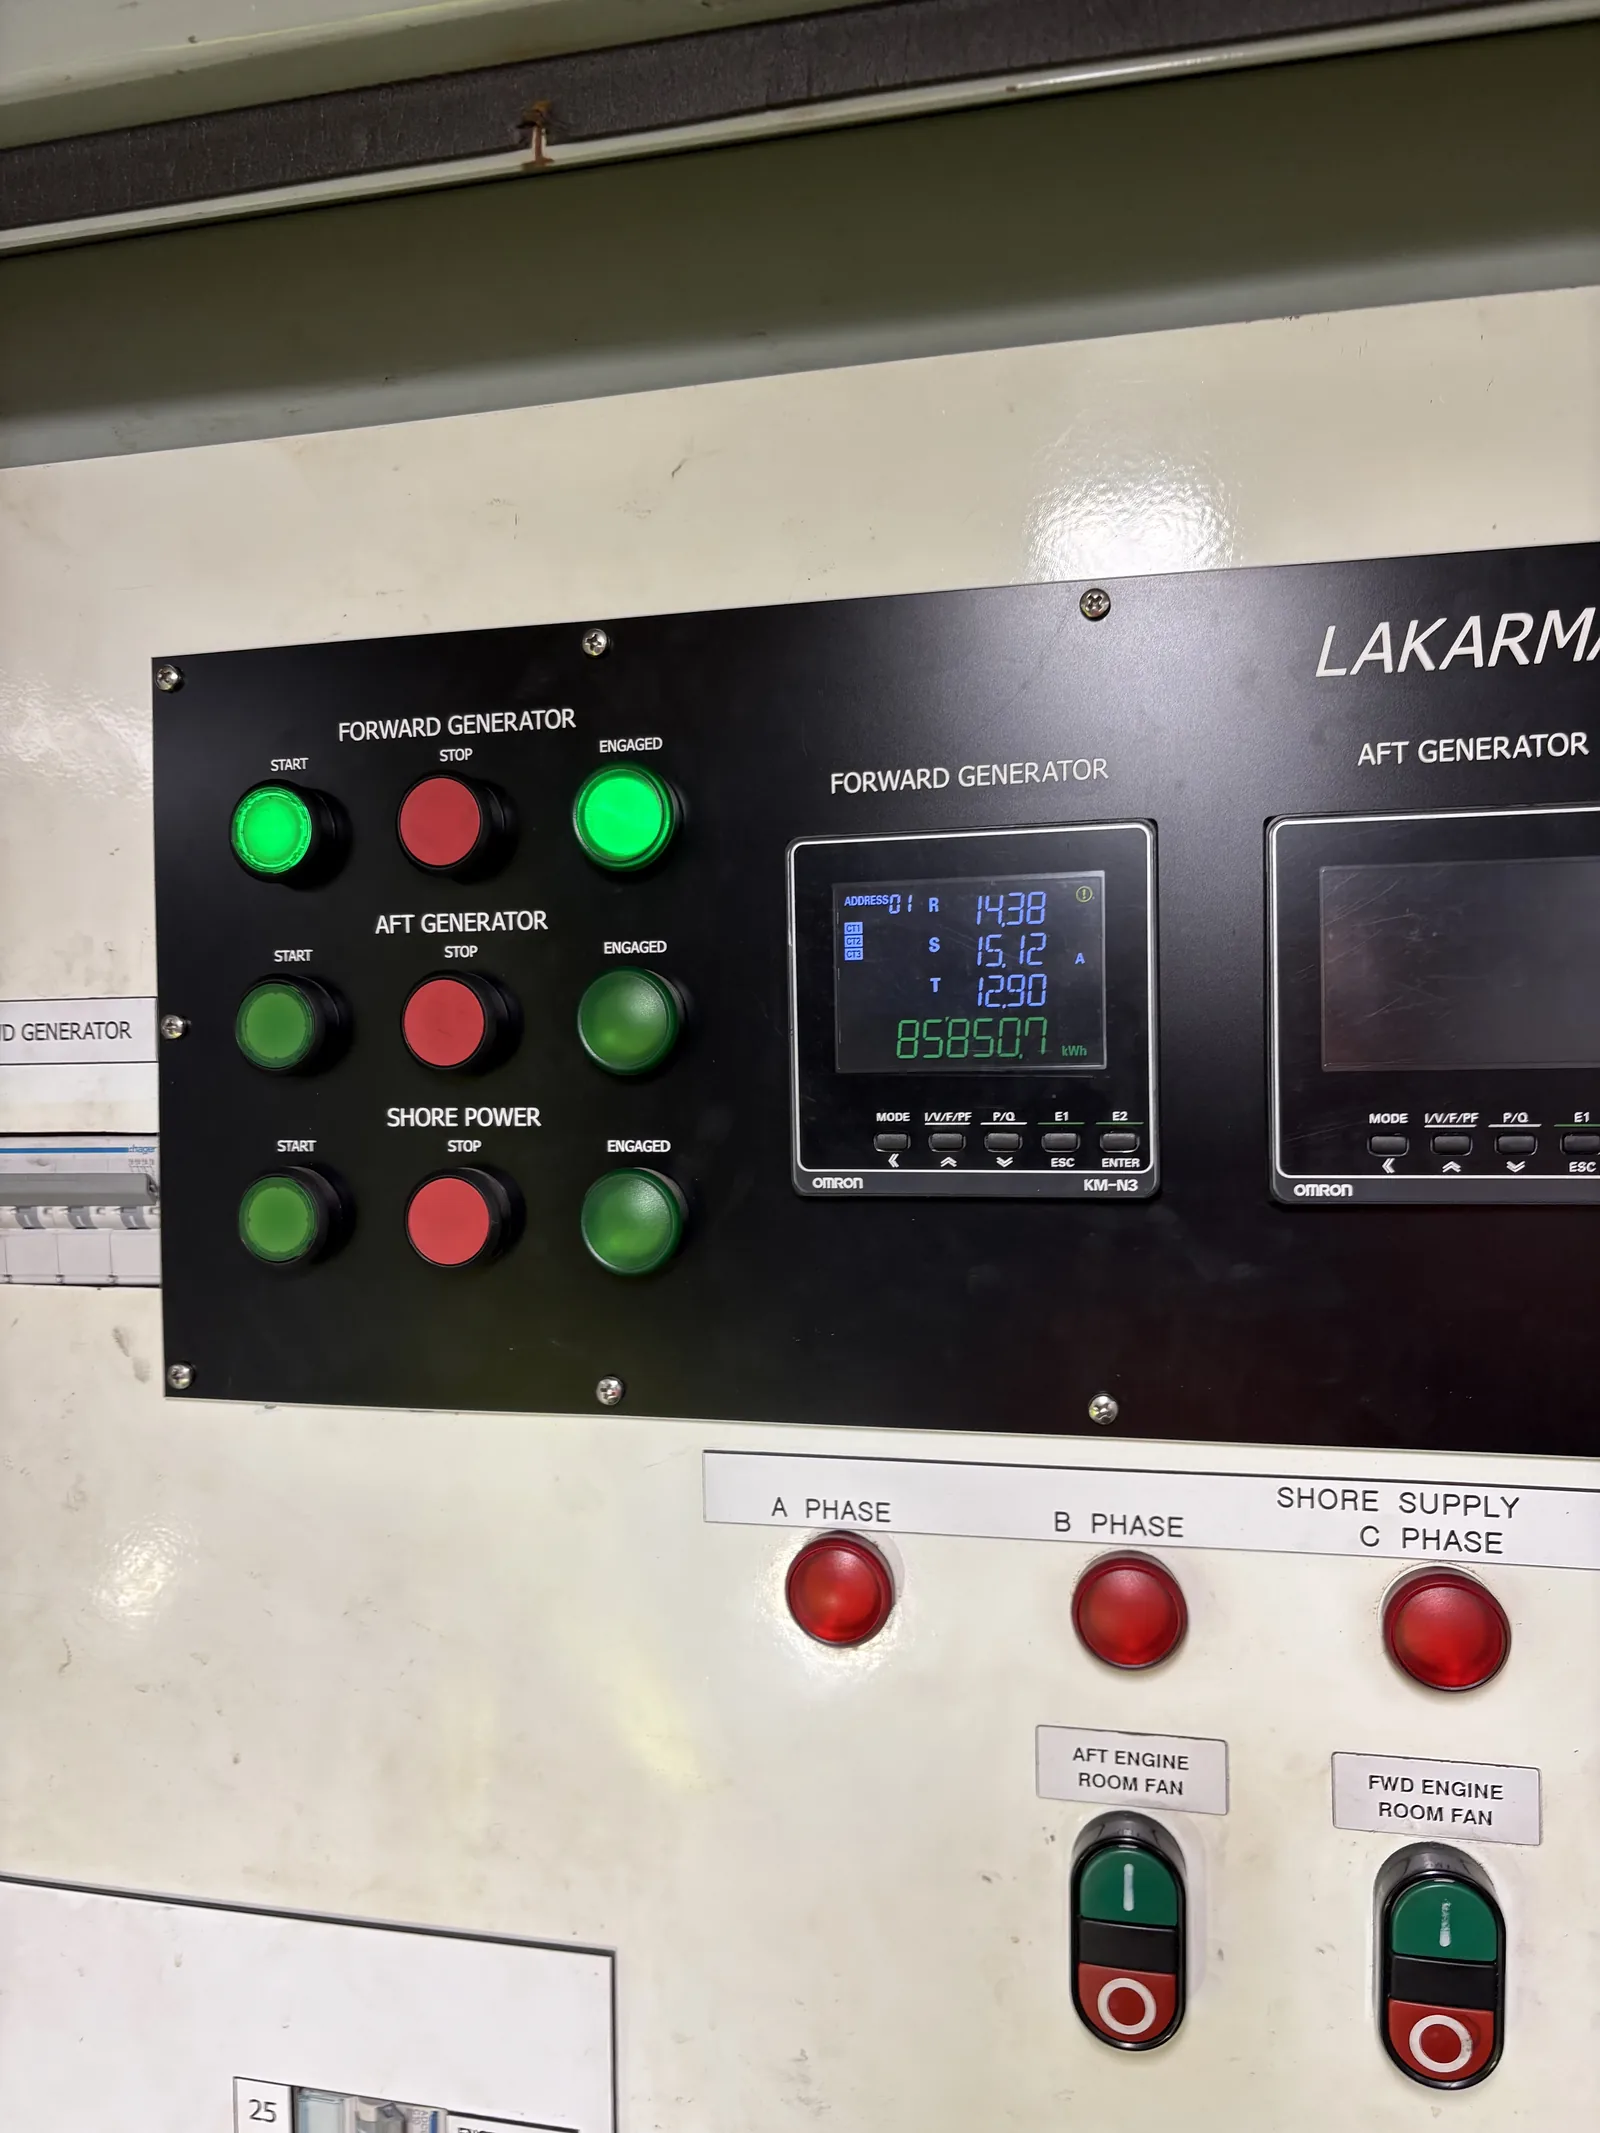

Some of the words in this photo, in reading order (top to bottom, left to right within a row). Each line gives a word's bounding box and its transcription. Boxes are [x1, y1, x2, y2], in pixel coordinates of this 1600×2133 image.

[1316, 607, 1600, 677] LAKARM
[339, 717, 441, 741] FORWARD
[448, 709, 576, 735] GENERATOR
[600, 737, 662, 752] ENGAGED
[1358, 741, 1409, 766] AFT
[1418, 732, 1589, 763] GENERATOR
[440, 748, 472, 761] STOP
[271, 758, 308, 771] START
[832, 768, 949, 794] FORWARD
[959, 758, 1109, 786] GENERATOR
[844, 895, 889, 906] ADDRESS
[889, 894, 913, 914] 01
[928, 897, 939, 912] R
[976, 891, 1046, 927] 14.38
[376, 915, 415, 934] AFT
[422, 911, 548, 933] GENERATOR
[845, 923, 862, 934] CT1
[604, 941, 667, 954] ENGAGED
[845, 936, 863, 947] CT2
[275, 950, 313, 962] START
[445, 945, 478, 958] STOP
[845, 949, 863, 960] CT3
[928, 937, 941, 953] S
[976, 932, 1047, 968] 15.12
[1074, 952, 1086, 965] A
[929, 977, 941, 993] T
[976, 973, 1047, 1009] 12.90
[0, 1024, 14, 1041] D
[22, 1021, 131, 1041] GENERATOR
[1061, 1045, 1088, 1057] kWh
[387, 1108, 458, 1127] SHORE
[465, 1107, 541, 1126] POWER
[876, 1112, 911, 1122] MODE
[924, 1112, 972, 1122] I/V/F/PF
[993, 1112, 1016, 1122] P/Q
[1055, 1112, 1069, 1121] E1
[1112, 1112, 1128, 1121] E2
[1368, 1113, 1409, 1125] MODE
[1424, 1112, 1480, 1125] I/V/F/PF
[1503, 1111, 1529, 1124] P/Q
[1574, 1112, 1590, 1123] E1
[278, 1140, 317, 1152] START
[448, 1140, 481, 1152] STOP
[608, 1140, 670, 1152] ENGAGED
[1051, 1158, 1075, 1168] ESC
[1102, 1158, 1140, 1169] ENTER
[1569, 1161, 1597, 1173] ESC
[1083, 1178, 1139, 1192] KM-N3
[1277, 1487, 1378, 1511] SHORE
[1399, 1493, 1519, 1518] SUPPLY
[772, 1497, 787, 1517] A
[805, 1499, 890, 1522] PHASE
[1055, 1512, 1070, 1532] B
[1092, 1513, 1183, 1537] PHASE
[1361, 1526, 1379, 1547] C
[1401, 1528, 1503, 1554] PHASE
[1073, 1748, 1108, 1762] AFT
[1116, 1751, 1188, 1770] ENGINE
[1079, 1773, 1137, 1791] ROOM
[1146, 1779, 1182, 1795] FAN
[1369, 1775, 1413, 1792] FWD
[1422, 1780, 1503, 1800] ENGINE
[1379, 1802, 1443, 1821] ROOM
[1452, 1808, 1492, 1825] FAN
[250, 2099, 276, 2122] 25
